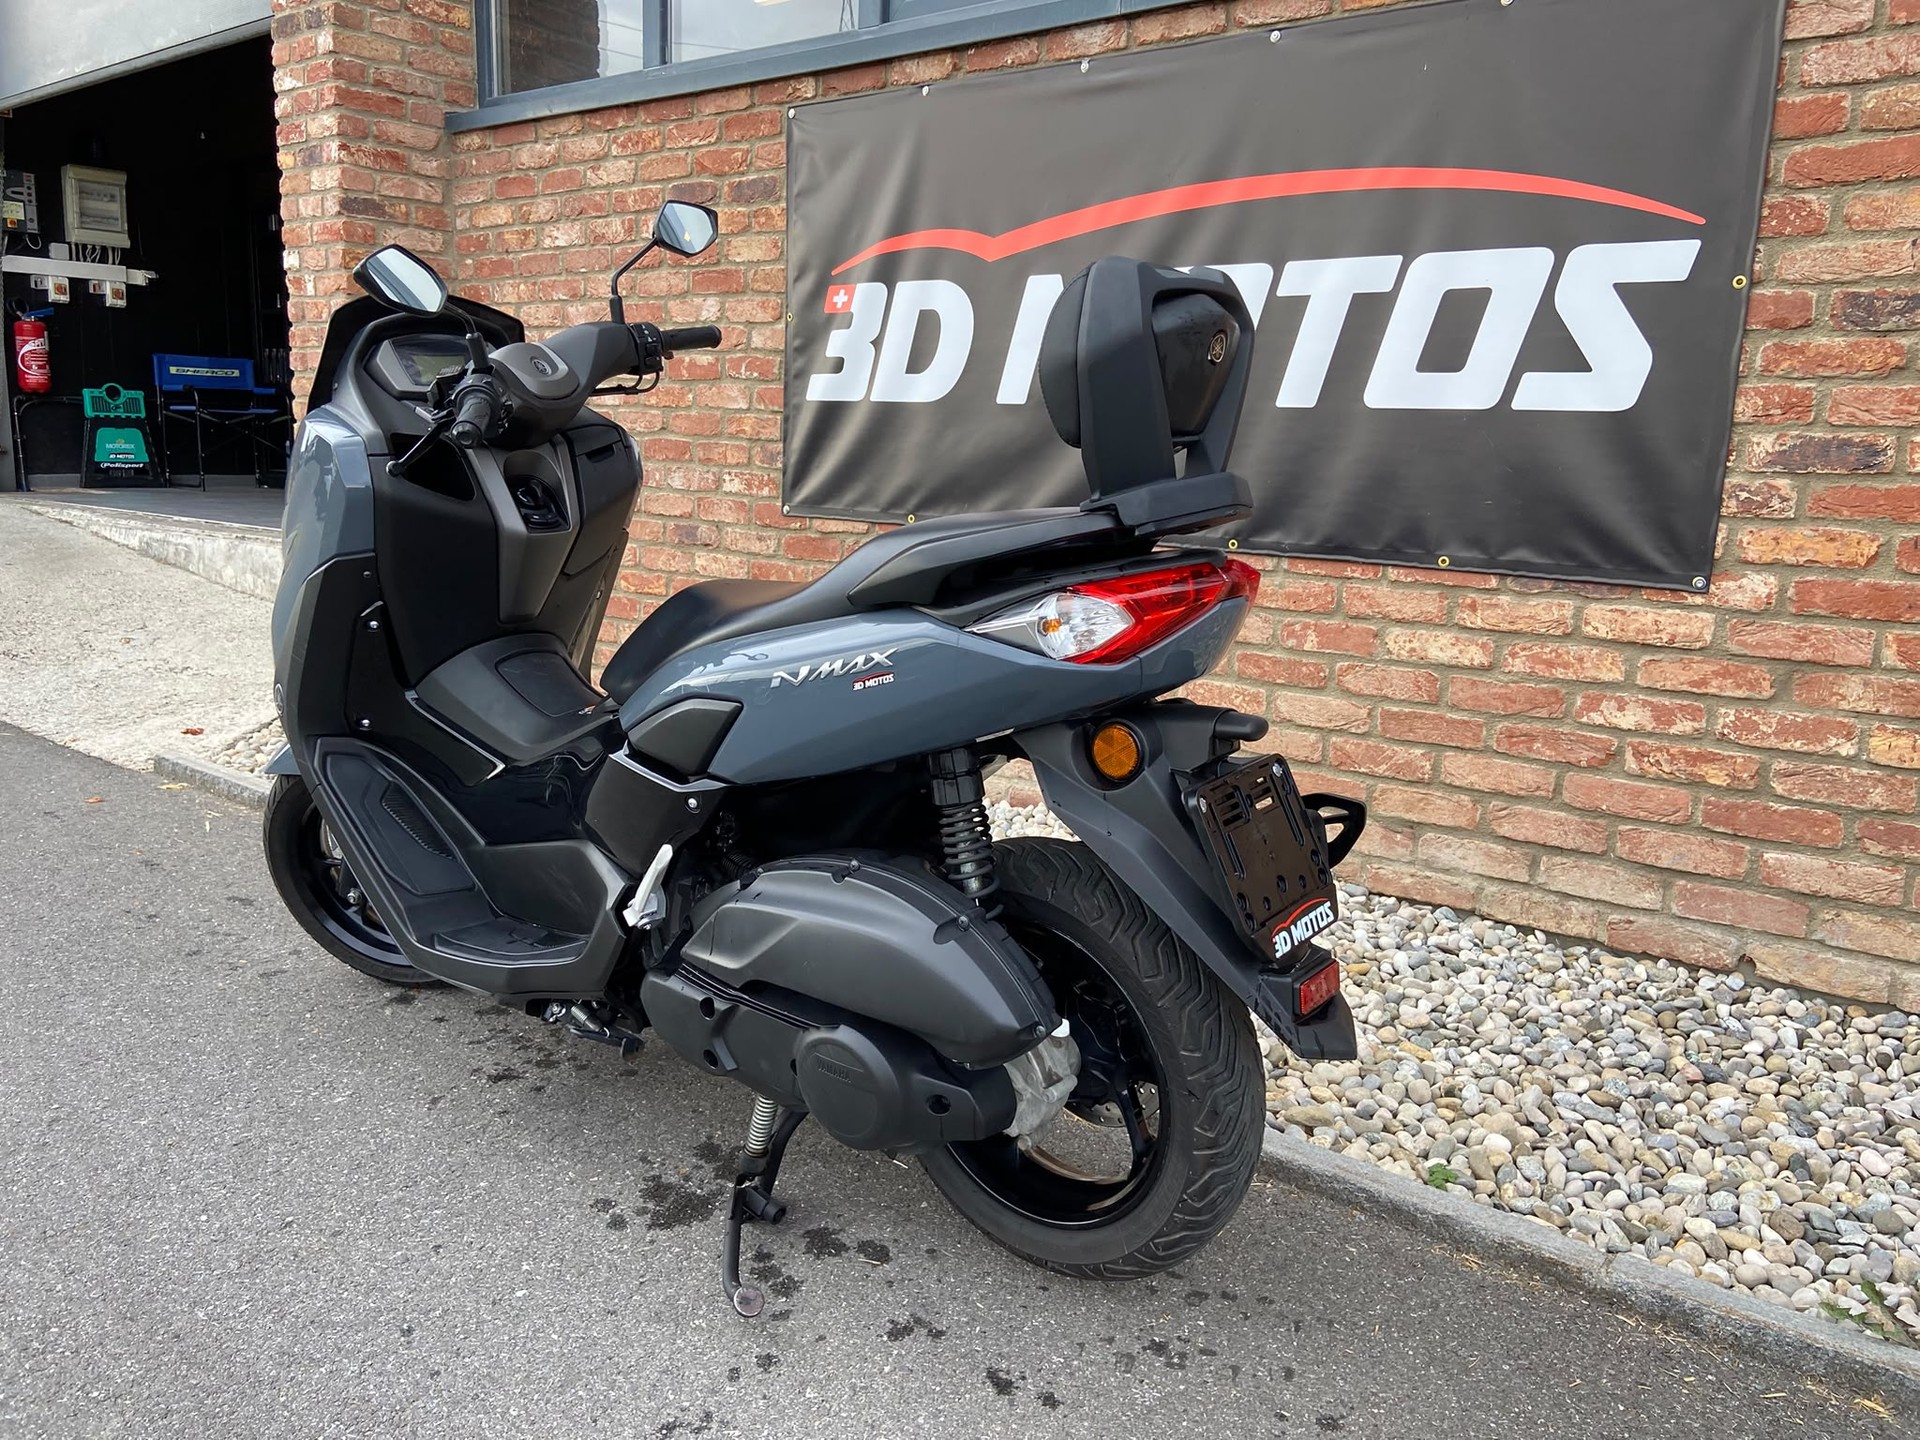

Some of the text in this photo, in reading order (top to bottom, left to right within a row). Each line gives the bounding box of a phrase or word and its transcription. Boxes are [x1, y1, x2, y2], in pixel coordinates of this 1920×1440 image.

[806, 279, 975, 403] 3D
[176, 368, 235, 376] SHERCO
[770, 648, 898, 688] NMAX
[853, 674, 895, 691] 3D MOTOS
[1273, 901, 1335, 959] 3D MOTOS
